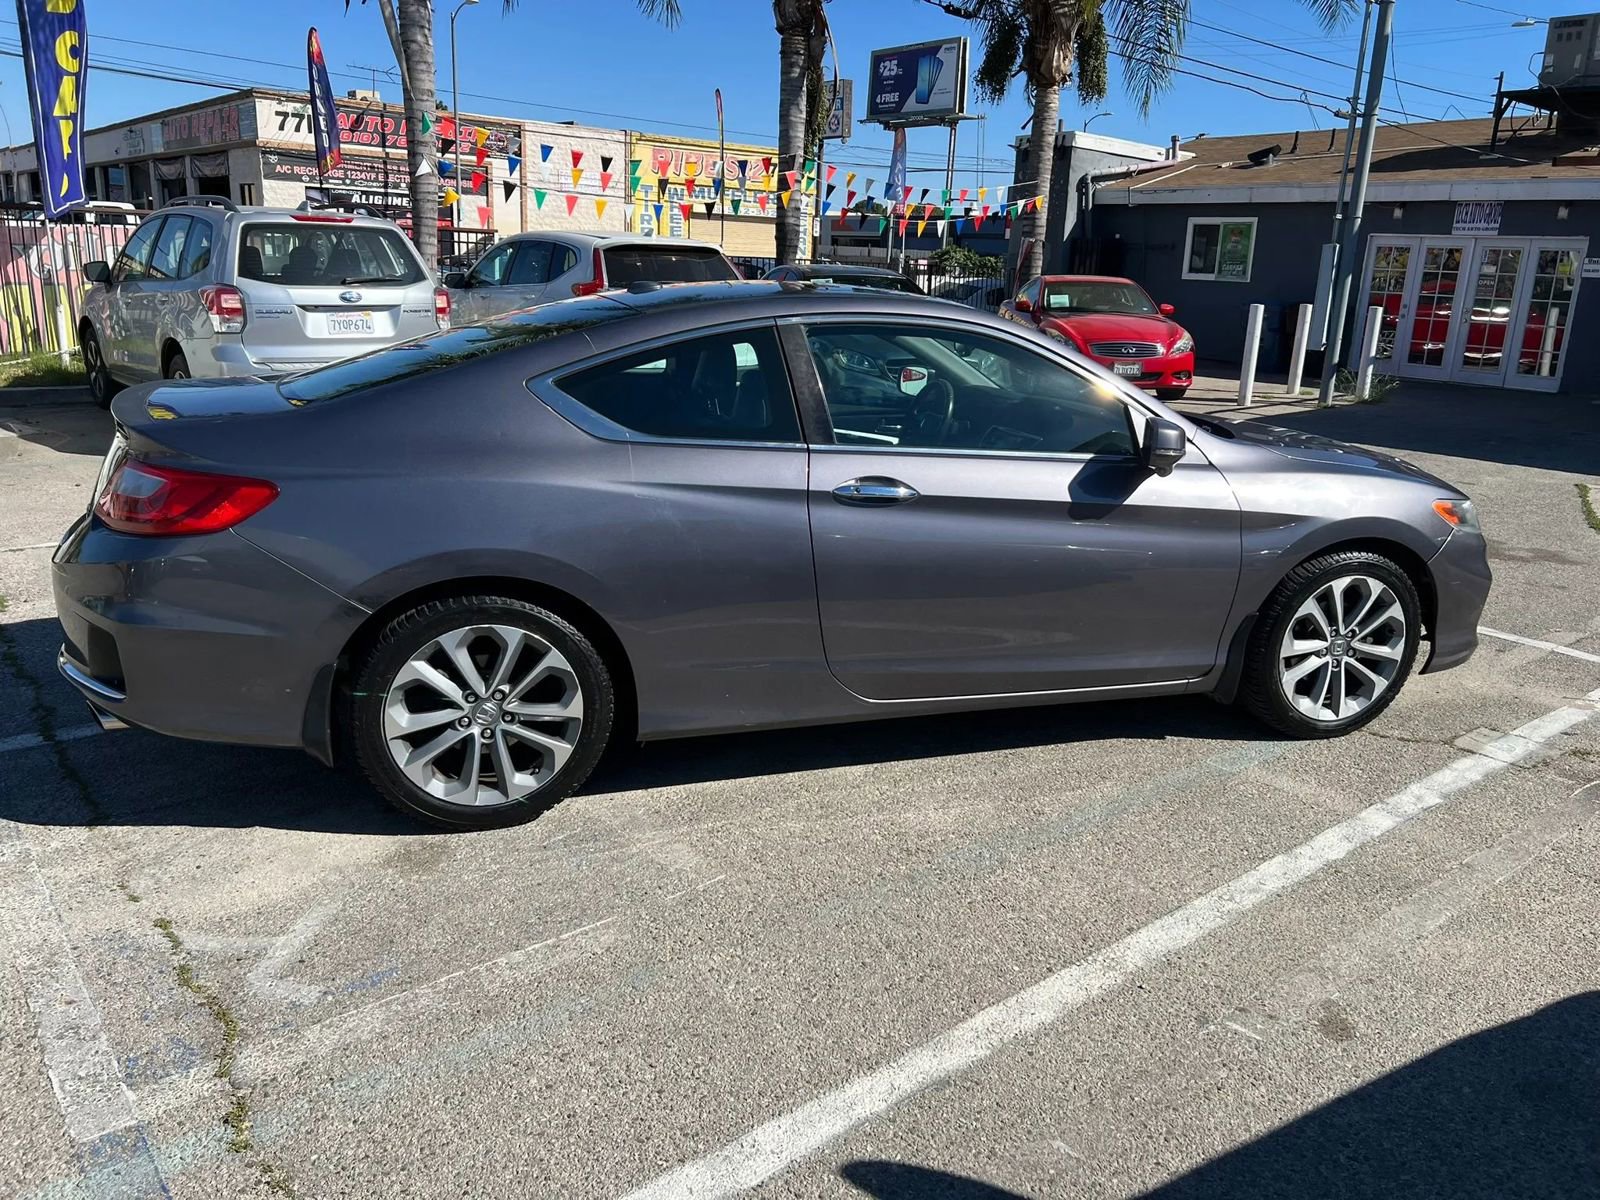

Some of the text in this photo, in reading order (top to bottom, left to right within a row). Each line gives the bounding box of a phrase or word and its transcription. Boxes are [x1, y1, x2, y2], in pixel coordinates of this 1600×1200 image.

[879, 60, 898, 76] $25
[876, 92, 900, 104] 4 FREE
[336, 112, 395, 134] AUTO
[294, 166, 345, 178] RECHRGE
